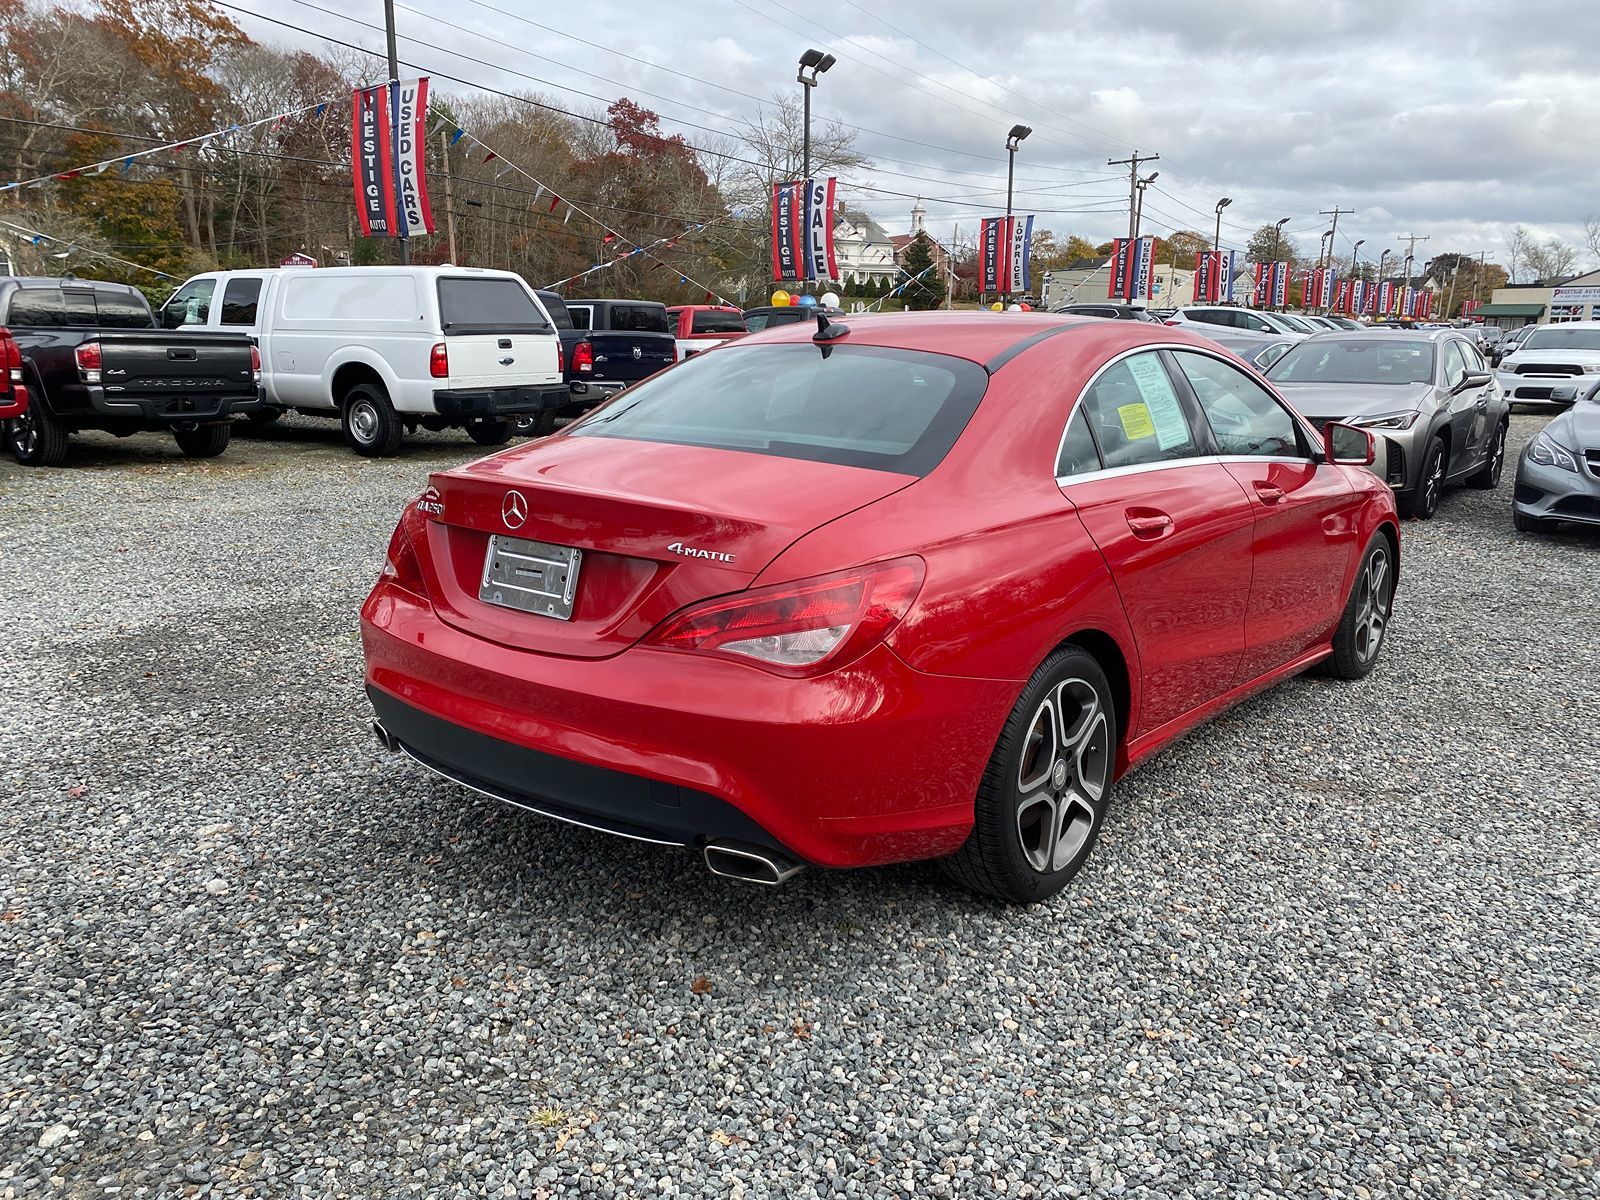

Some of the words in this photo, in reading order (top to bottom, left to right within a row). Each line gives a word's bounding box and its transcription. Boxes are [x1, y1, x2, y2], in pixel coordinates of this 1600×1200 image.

[400, 89, 415, 155] USED
[400, 160, 420, 226] CARS
[369, 219, 387, 230] AUTO
[811, 185, 826, 275] SALE
[1014, 221, 1024, 242] LOW
[986, 222, 996, 281] PRESTIGE
[1013, 244, 1023, 287] PRICES
[1142, 242, 1151, 263] USED
[781, 269, 796, 278] AUTO
[1139, 264, 1148, 295] TRUCKS
[1260, 264, 1268, 299] PRETIGE
[667, 542, 737, 563] 4MATIC
